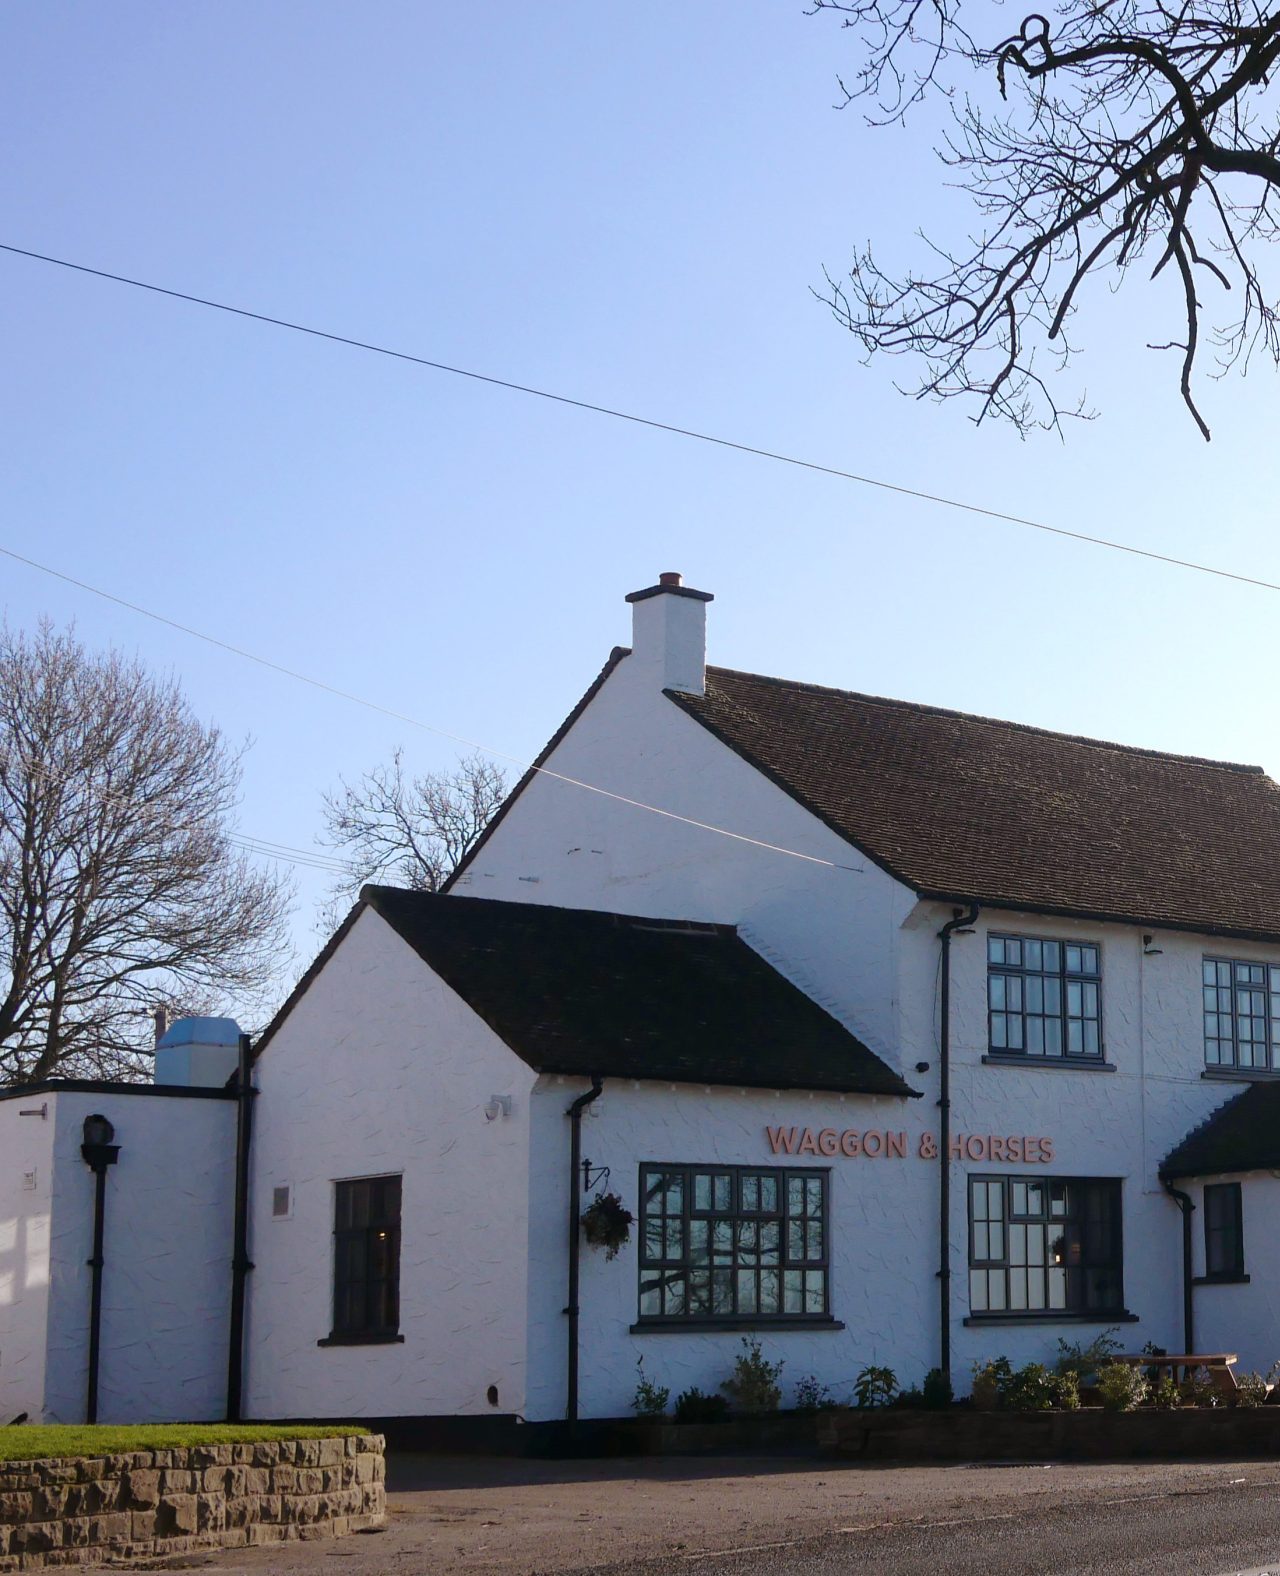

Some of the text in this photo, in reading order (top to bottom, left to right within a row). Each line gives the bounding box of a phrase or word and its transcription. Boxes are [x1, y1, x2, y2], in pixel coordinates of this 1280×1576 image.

[766, 1126, 1056, 1163] WAGGON & HORSES
